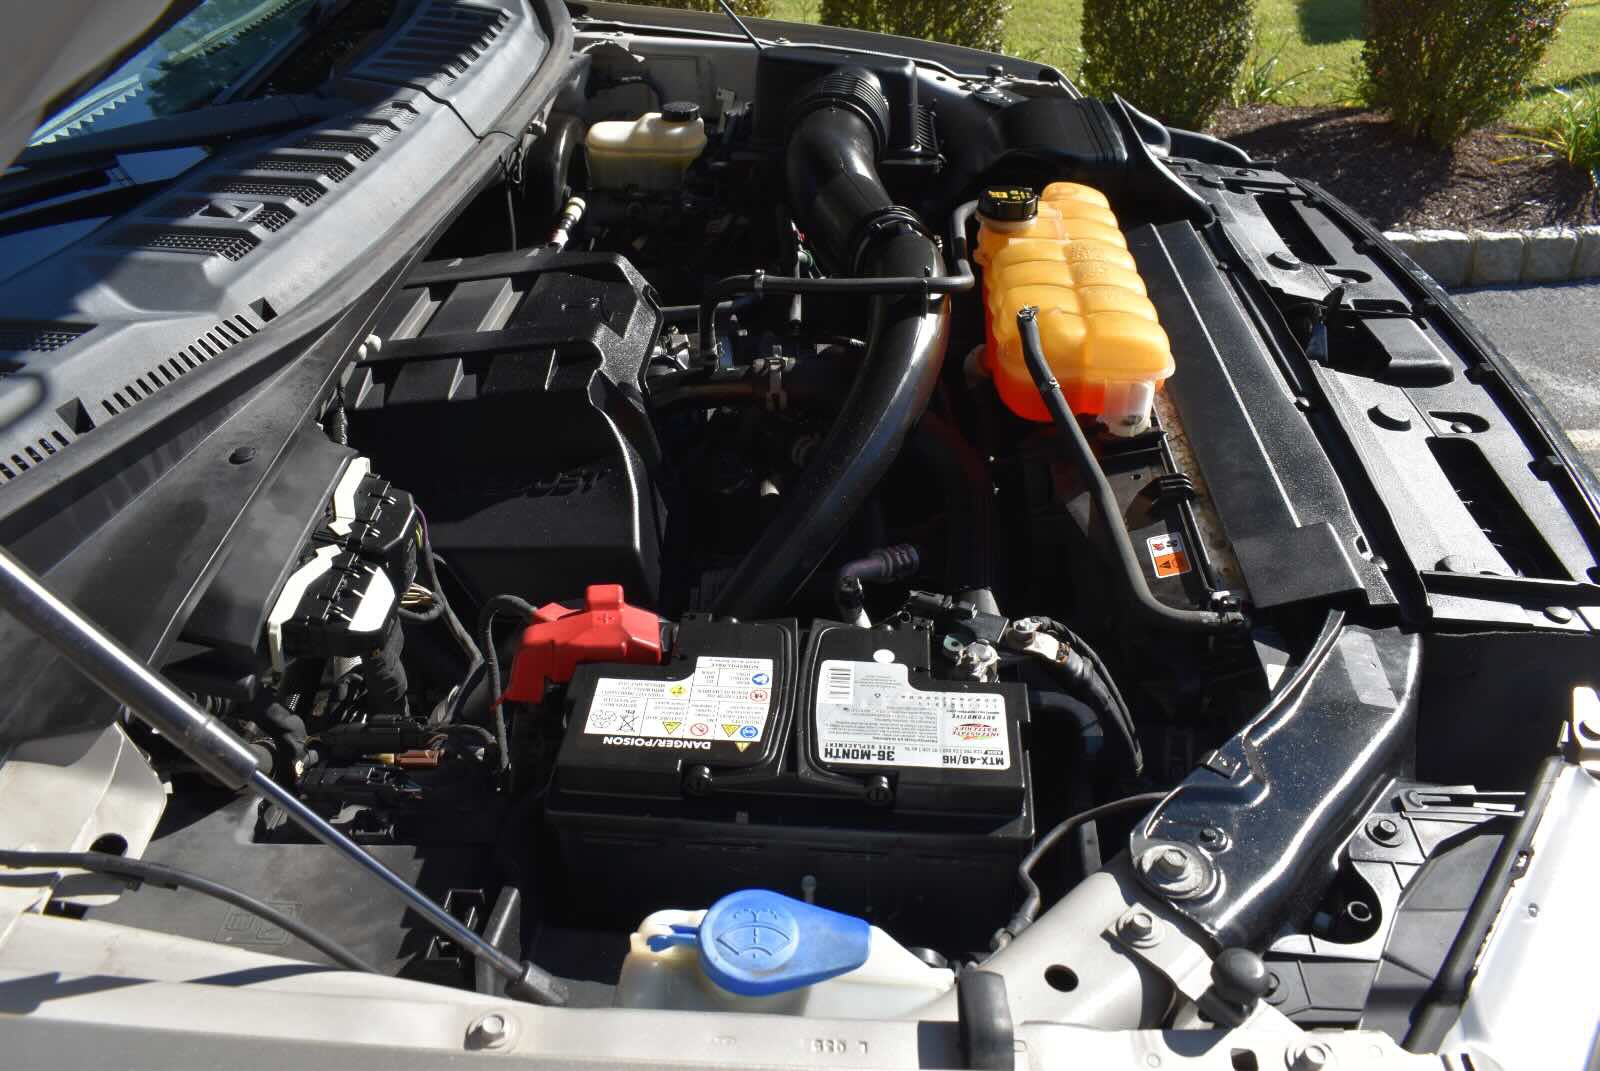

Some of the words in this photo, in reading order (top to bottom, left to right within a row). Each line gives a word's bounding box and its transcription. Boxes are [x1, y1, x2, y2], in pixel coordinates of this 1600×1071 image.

[603, 736, 711, 750] DANGER/POISON
[825, 742, 875, 750] REPLACEMENT
[824, 747, 895, 761] 36-MONTH
[942, 754, 1004, 766] MTX-48/H6
